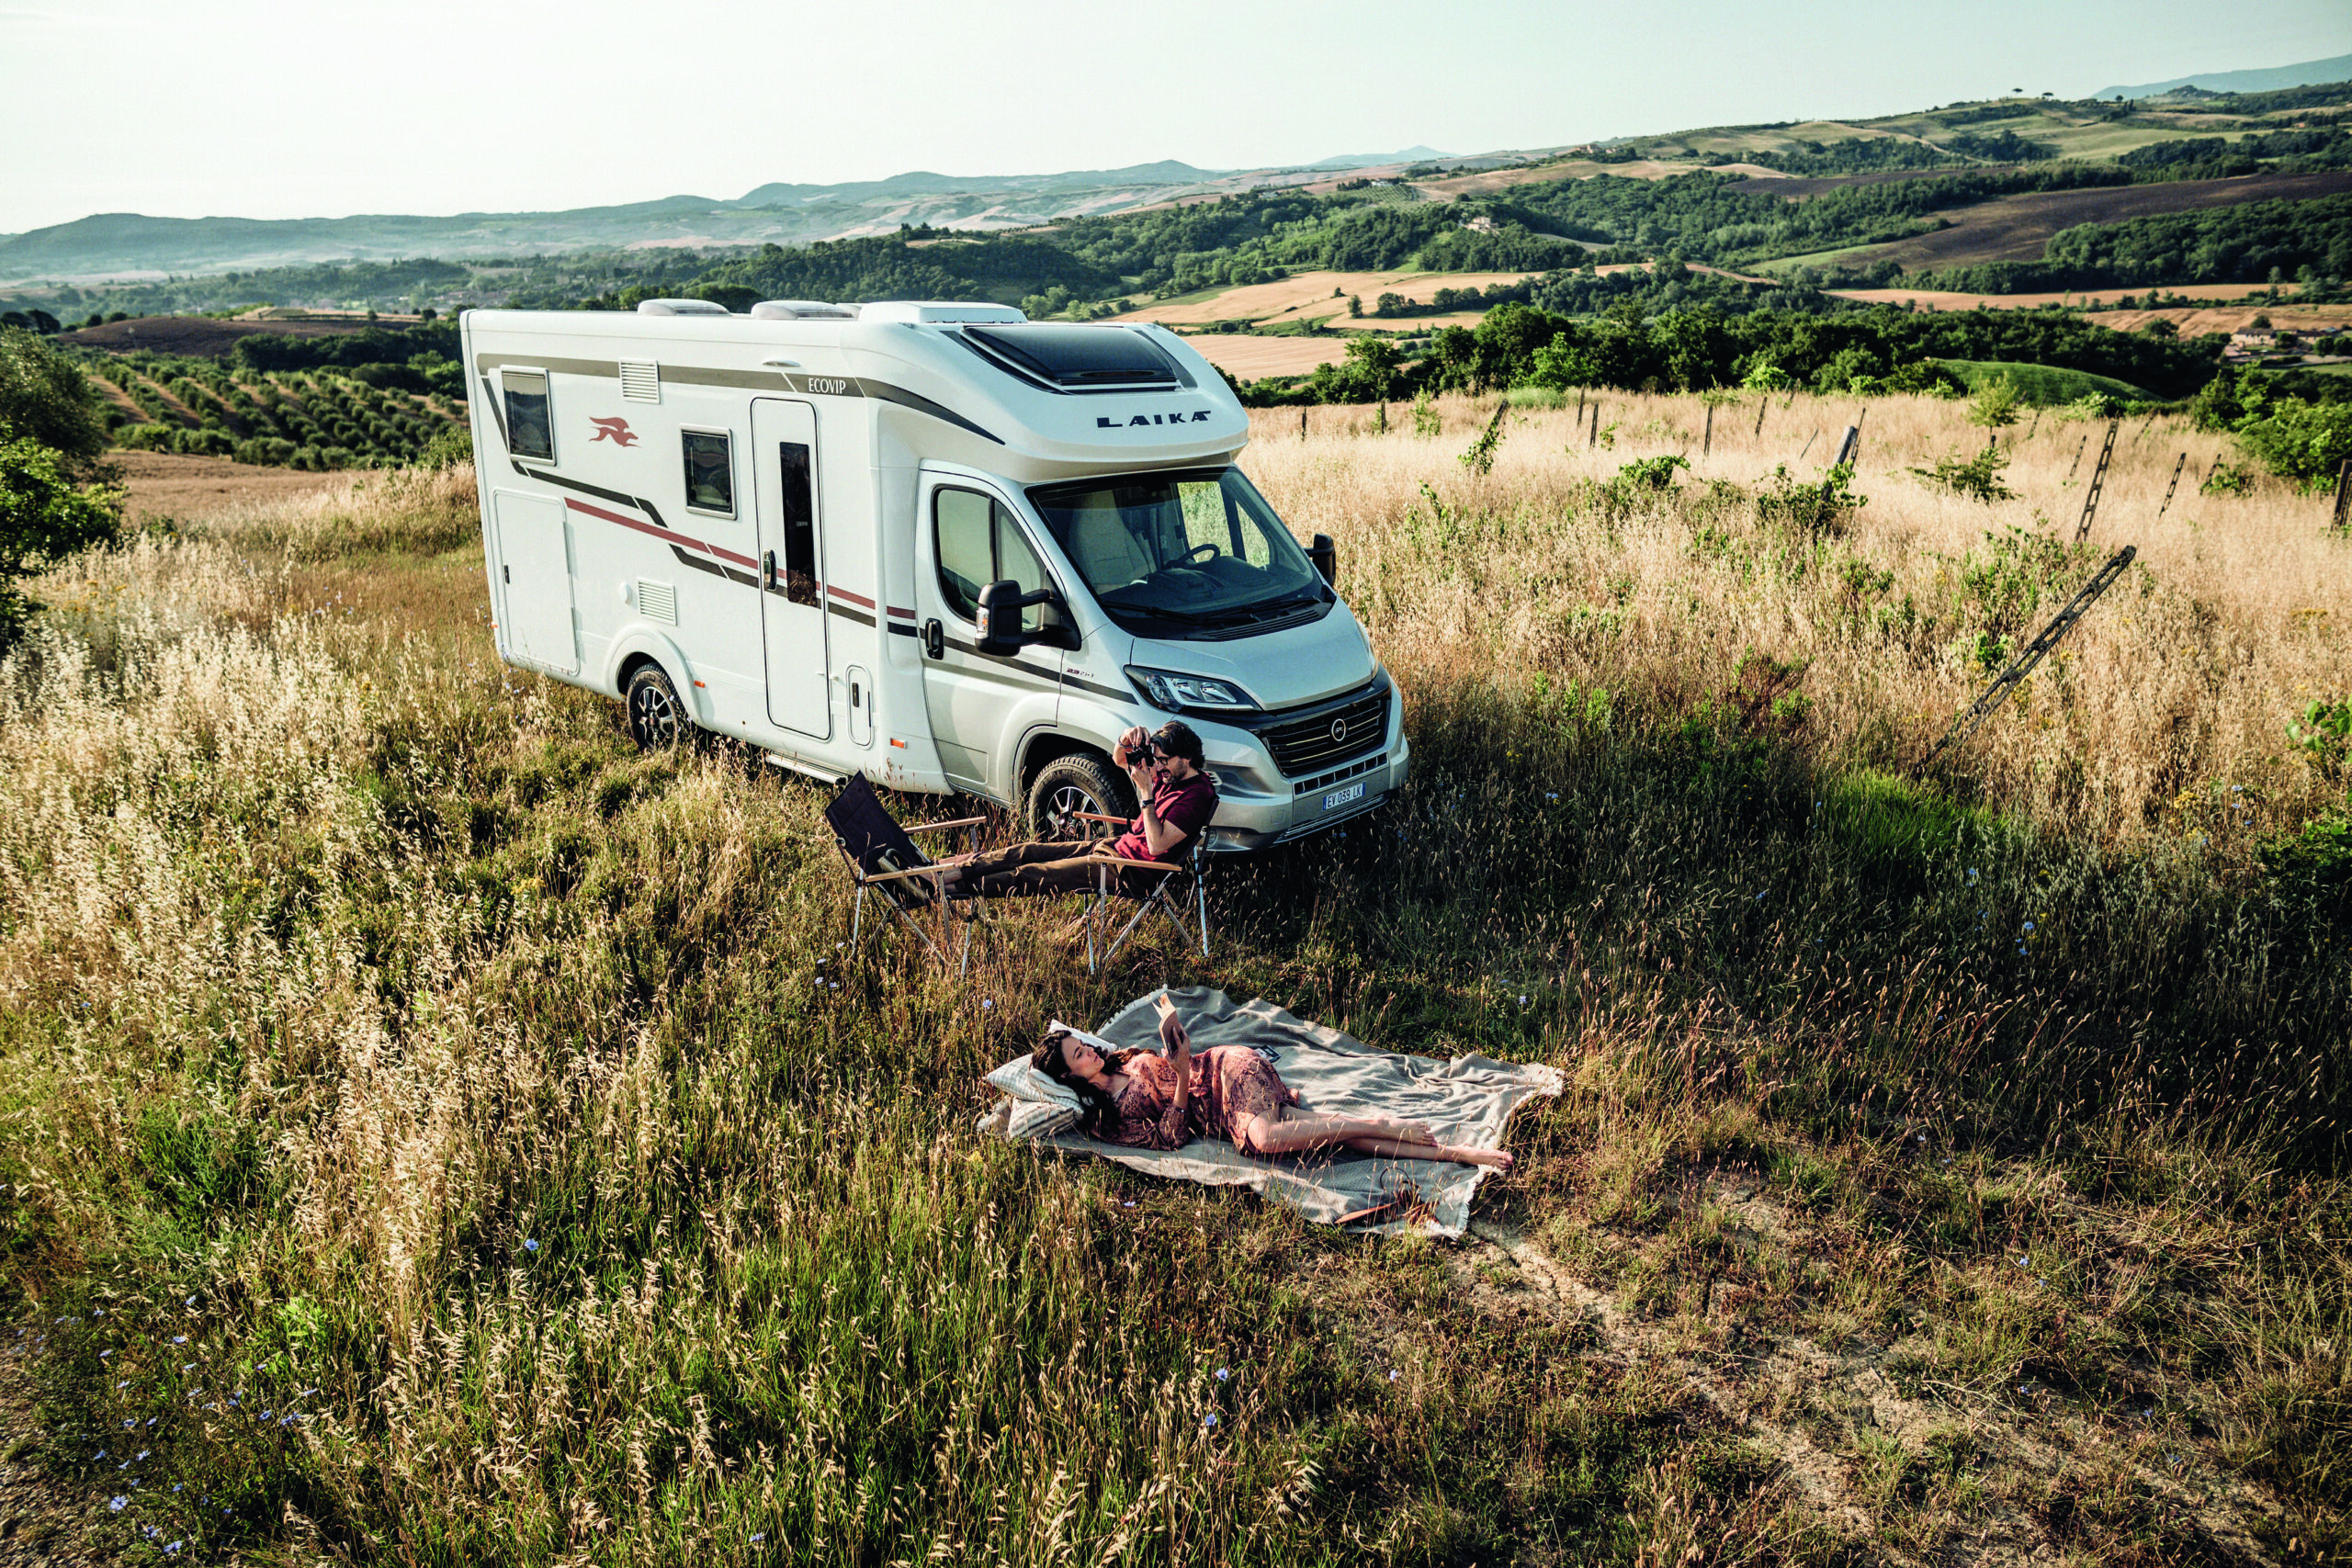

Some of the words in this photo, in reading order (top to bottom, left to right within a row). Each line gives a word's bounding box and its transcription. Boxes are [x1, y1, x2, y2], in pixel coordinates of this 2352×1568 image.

[808, 378, 846, 394] ECOVIP
[1096, 410, 1212, 428] LAIKA
[1328, 794, 1337, 807] EV
[1338, 789, 1351, 803] 039
[1352, 784, 1362, 797] LK
